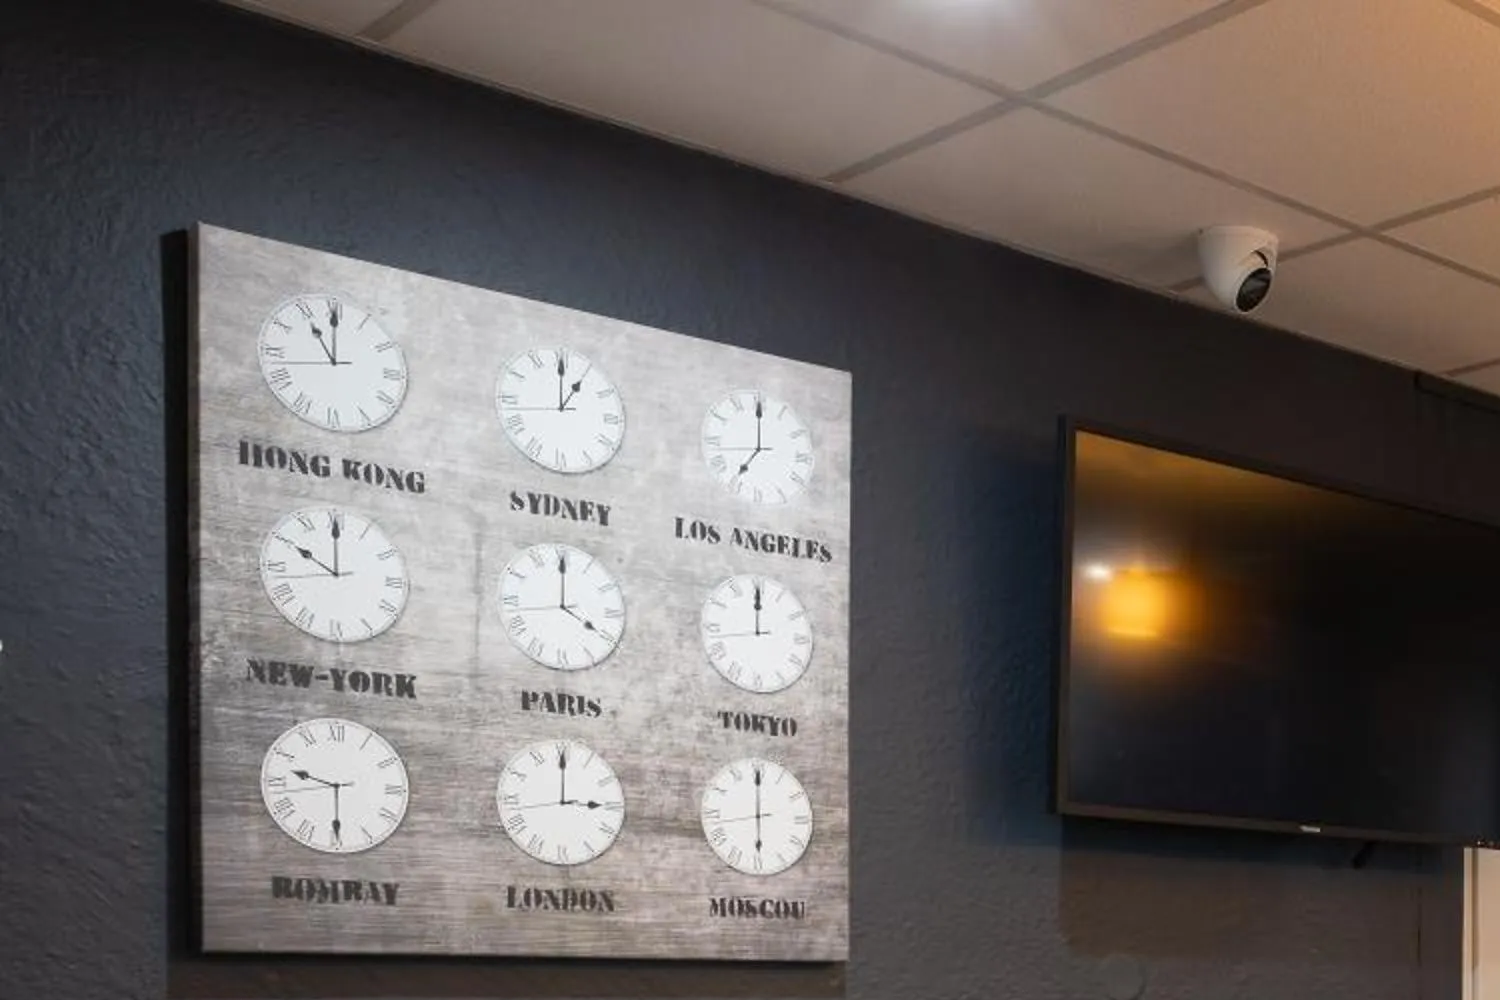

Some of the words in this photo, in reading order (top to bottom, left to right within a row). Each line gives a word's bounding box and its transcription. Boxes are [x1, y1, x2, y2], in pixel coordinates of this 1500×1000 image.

[238, 438, 331, 479] HONG
[341, 458, 426, 494] KONG
[509, 490, 612, 527] SYDNEY
[674, 516, 721, 545] LOS
[729, 526, 833, 563] ANGELES
[246, 658, 417, 700] NEW-YORK
[520, 690, 603, 718] PARIS
[716, 710, 798, 737] TOKYO
[271, 875, 400, 906] BOMBAY
[506, 885, 615, 912] LONDON
[708, 896, 806, 921] MOSCOU
